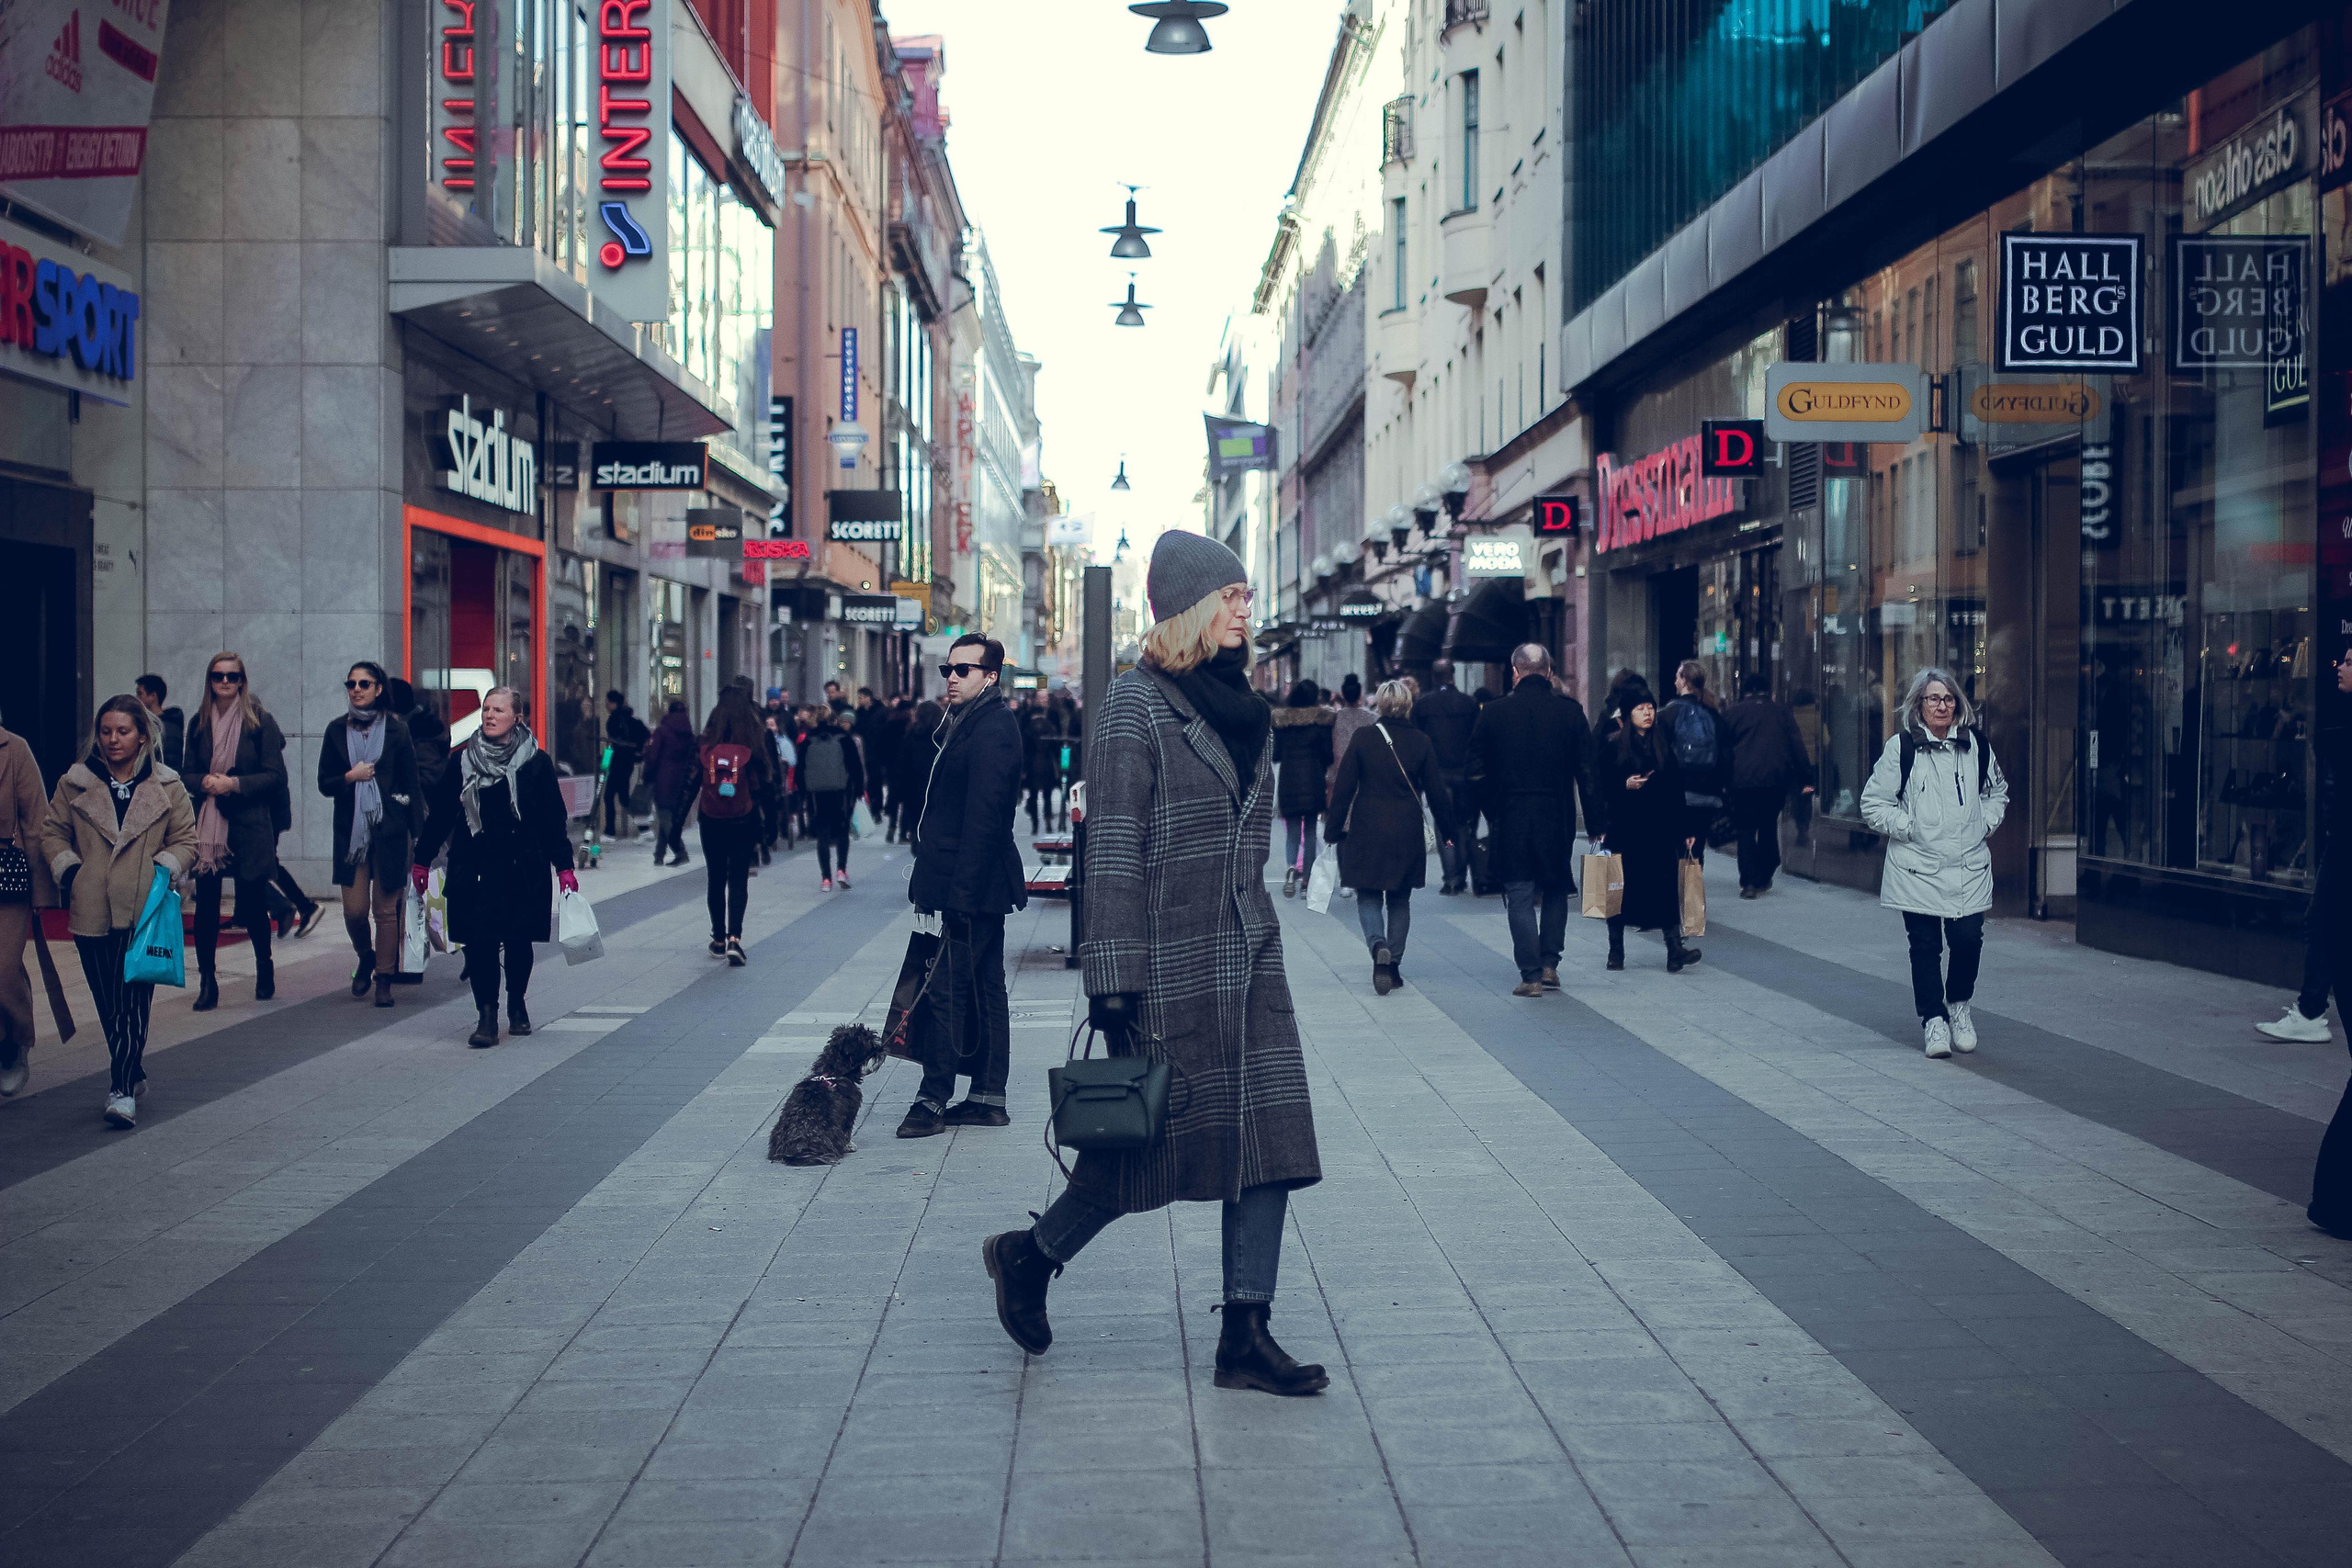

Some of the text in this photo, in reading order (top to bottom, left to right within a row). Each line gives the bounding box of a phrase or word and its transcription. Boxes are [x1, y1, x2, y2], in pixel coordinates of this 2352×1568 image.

[45, 55, 83, 94] adidas
[600, 0, 652, 190] INTER
[2023, 252, 2120, 280] HALL
[2020, 324, 2123, 355] GULD
[1789, 388, 1901, 414] GULDFYND
[447, 392, 537, 517] stadium
[595, 460, 699, 486] stadium
[831, 520, 901, 540] SCORETT
[1471, 540, 1520, 559] VERO
[1467, 555, 1523, 571] MODA
[844, 605, 896, 623] SCORETT
